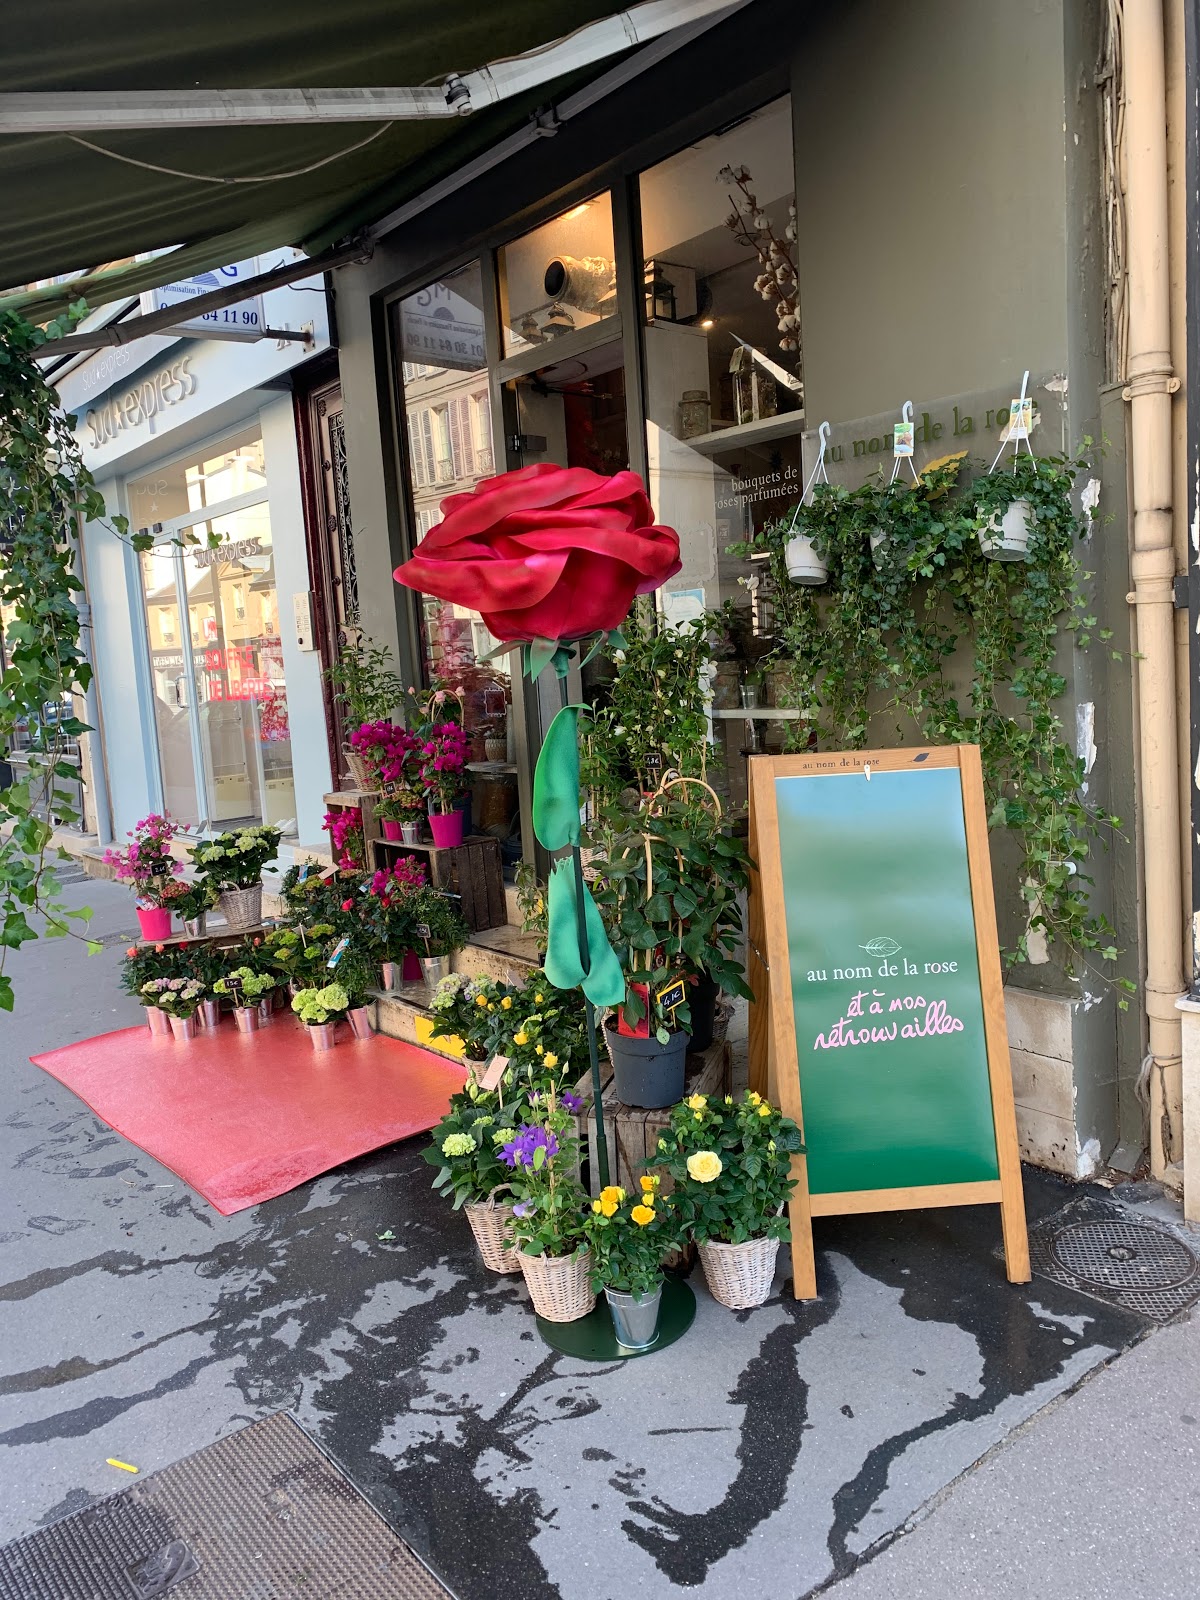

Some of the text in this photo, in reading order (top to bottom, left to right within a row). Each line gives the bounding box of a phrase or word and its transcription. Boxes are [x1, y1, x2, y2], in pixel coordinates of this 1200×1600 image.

[223, 309, 238, 324] 11
[242, 311, 258, 326] 90
[915, 413, 943, 442] de
[952, 406, 974, 437] la
[731, 465, 798, 491] bouquets de
[714, 482, 799, 509] roses parfumées
[209, 680, 223, 702] DE
[816, 761, 836, 769] nom
[840, 758, 850, 767] de
[853, 757, 861, 766] la
[807, 958, 958, 982] au nom de la rose
[847, 988, 927, 1018] et à nos
[813, 999, 965, 1051] retrouvailles
